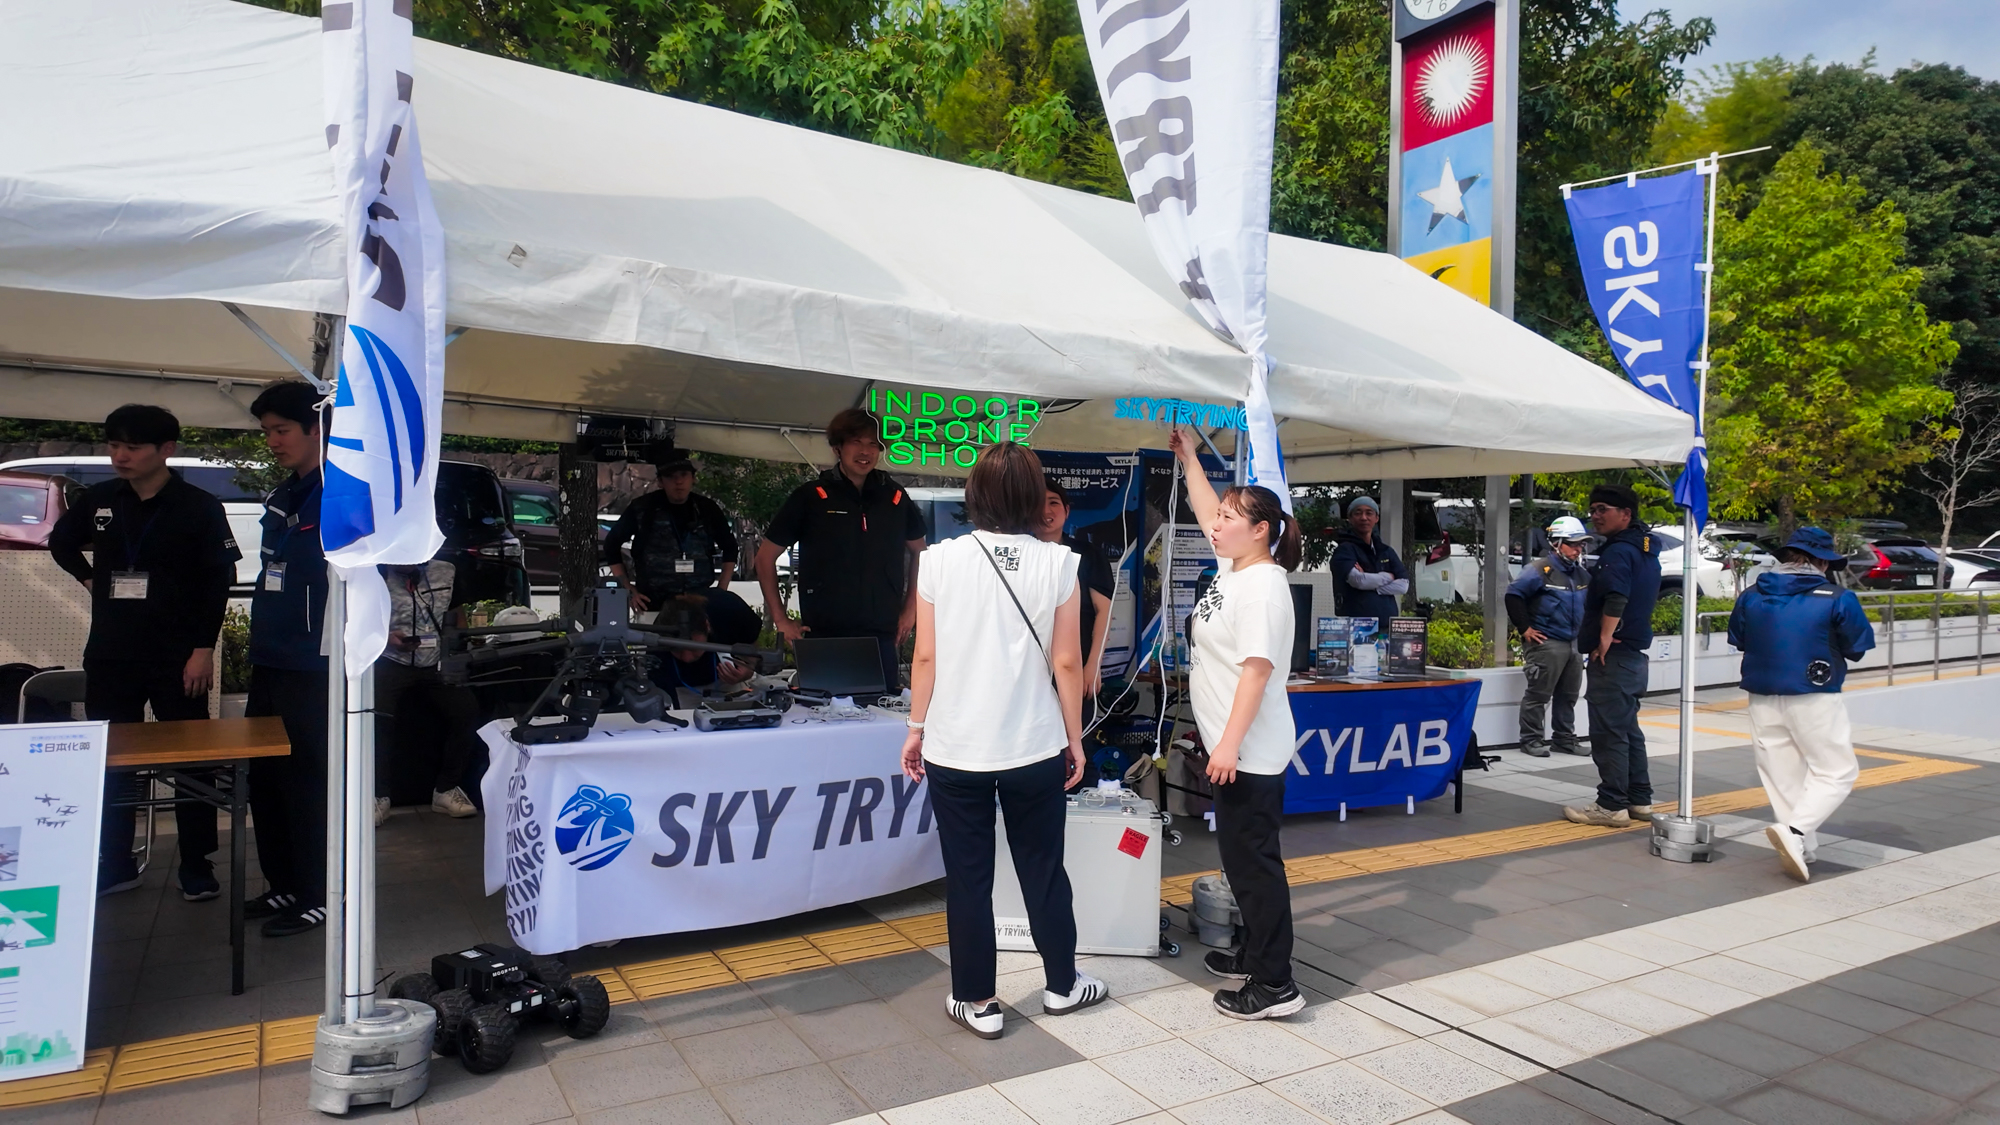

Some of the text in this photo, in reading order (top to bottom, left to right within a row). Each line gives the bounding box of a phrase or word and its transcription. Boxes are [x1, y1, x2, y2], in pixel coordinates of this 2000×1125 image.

[1439, 3, 1447, 12] 6
[871, 389, 1040, 422] INDOOR
[883, 416, 1030, 447] DRONE
[889, 441, 979, 468] SHO
[44, 742, 91, 752] 日本化薬
[1291, 719, 1451, 775] KYLAB
[651, 773, 940, 868] SKY TRYI
[1004, 928, 1032, 938] TRYING
